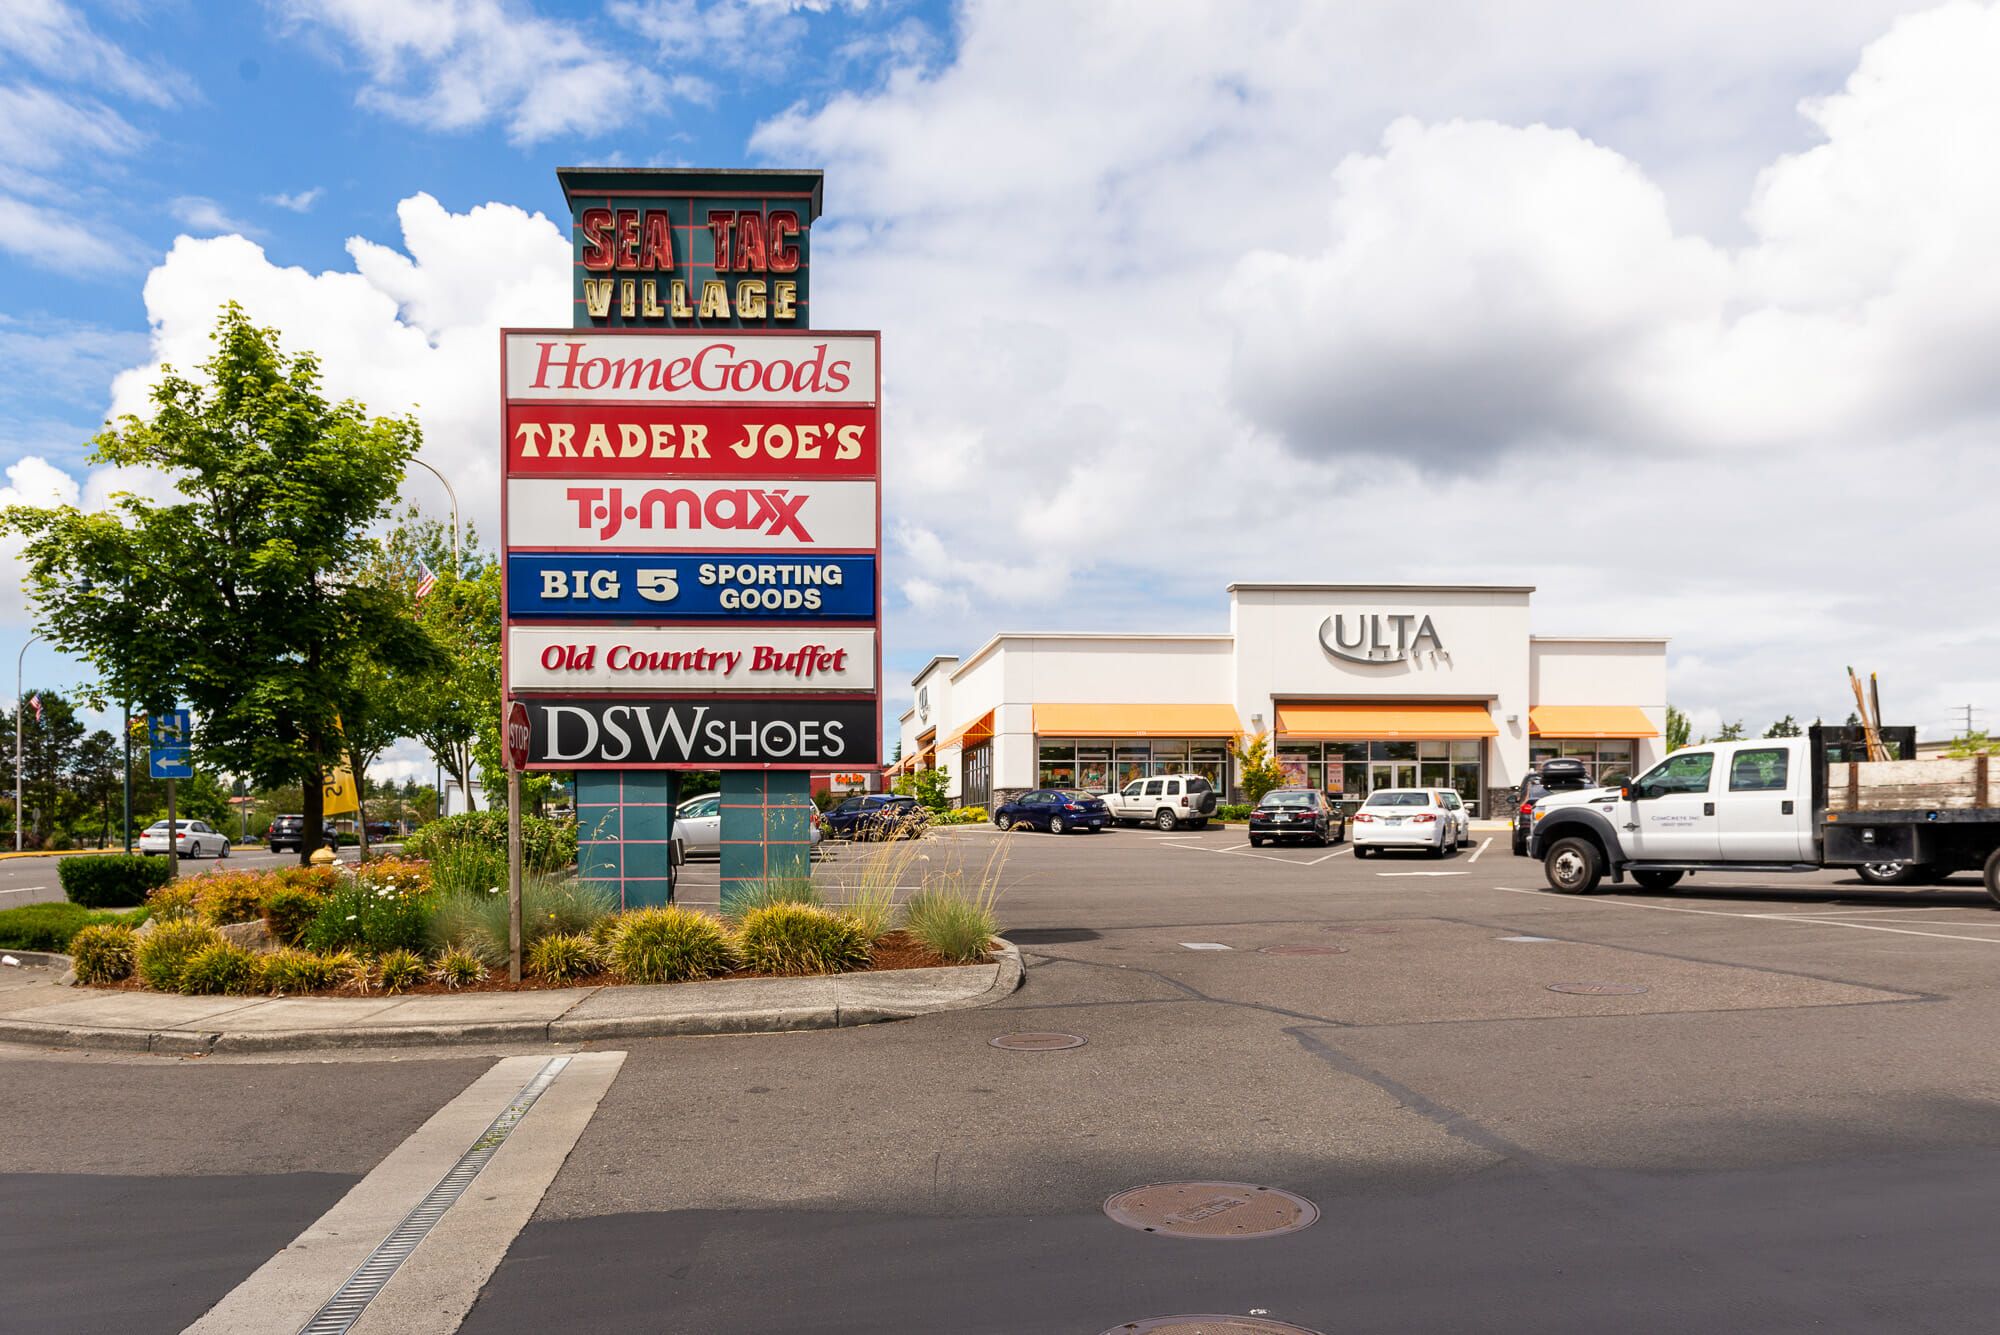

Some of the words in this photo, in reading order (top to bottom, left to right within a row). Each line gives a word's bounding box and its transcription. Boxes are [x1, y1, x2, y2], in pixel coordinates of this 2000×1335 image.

[581, 207, 675, 272] SEA
[707, 209, 800, 273] TAC
[583, 278, 796, 319] VILLAGE
[528, 342, 851, 394] HomeGoods
[515, 423, 711, 459] TRADER
[728, 422, 866, 460] JOE'S
[540, 570, 620, 600] BIG
[636, 568, 680, 602] 5
[699, 563, 842, 586] SPORTING
[719, 588, 821, 610] GOODS
[1335, 614, 1443, 649] ULTA
[540, 644, 595, 671] Old
[606, 645, 742, 676] Country
[749, 645, 848, 677] Buffet
[510, 722, 529, 751] STOP
